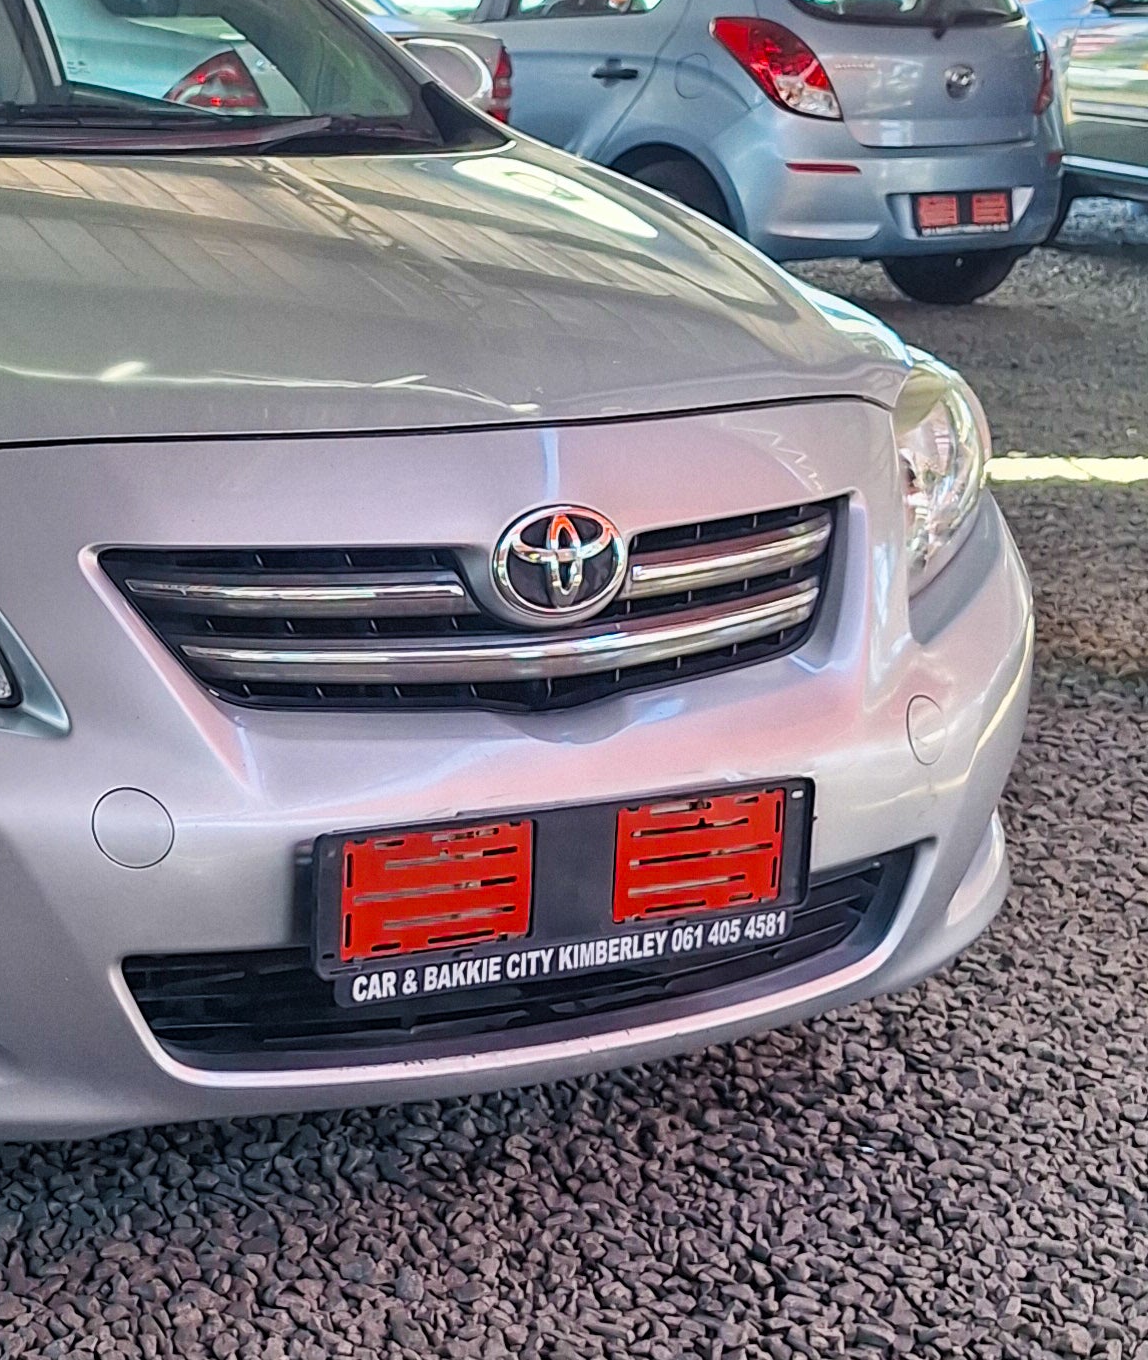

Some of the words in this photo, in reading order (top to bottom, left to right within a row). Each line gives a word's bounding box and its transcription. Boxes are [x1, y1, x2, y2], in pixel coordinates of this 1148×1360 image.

[352, 970, 397, 1003] CAR
[402, 968, 418, 996] &
[423, 956, 502, 991] BAKKIE
[506, 946, 555, 980] CITY
[558, 929, 669, 972] KIMBERLEY
[671, 923, 704, 953] 061
[708, 917, 742, 946] 405
[744, 910, 787, 940] 4581
